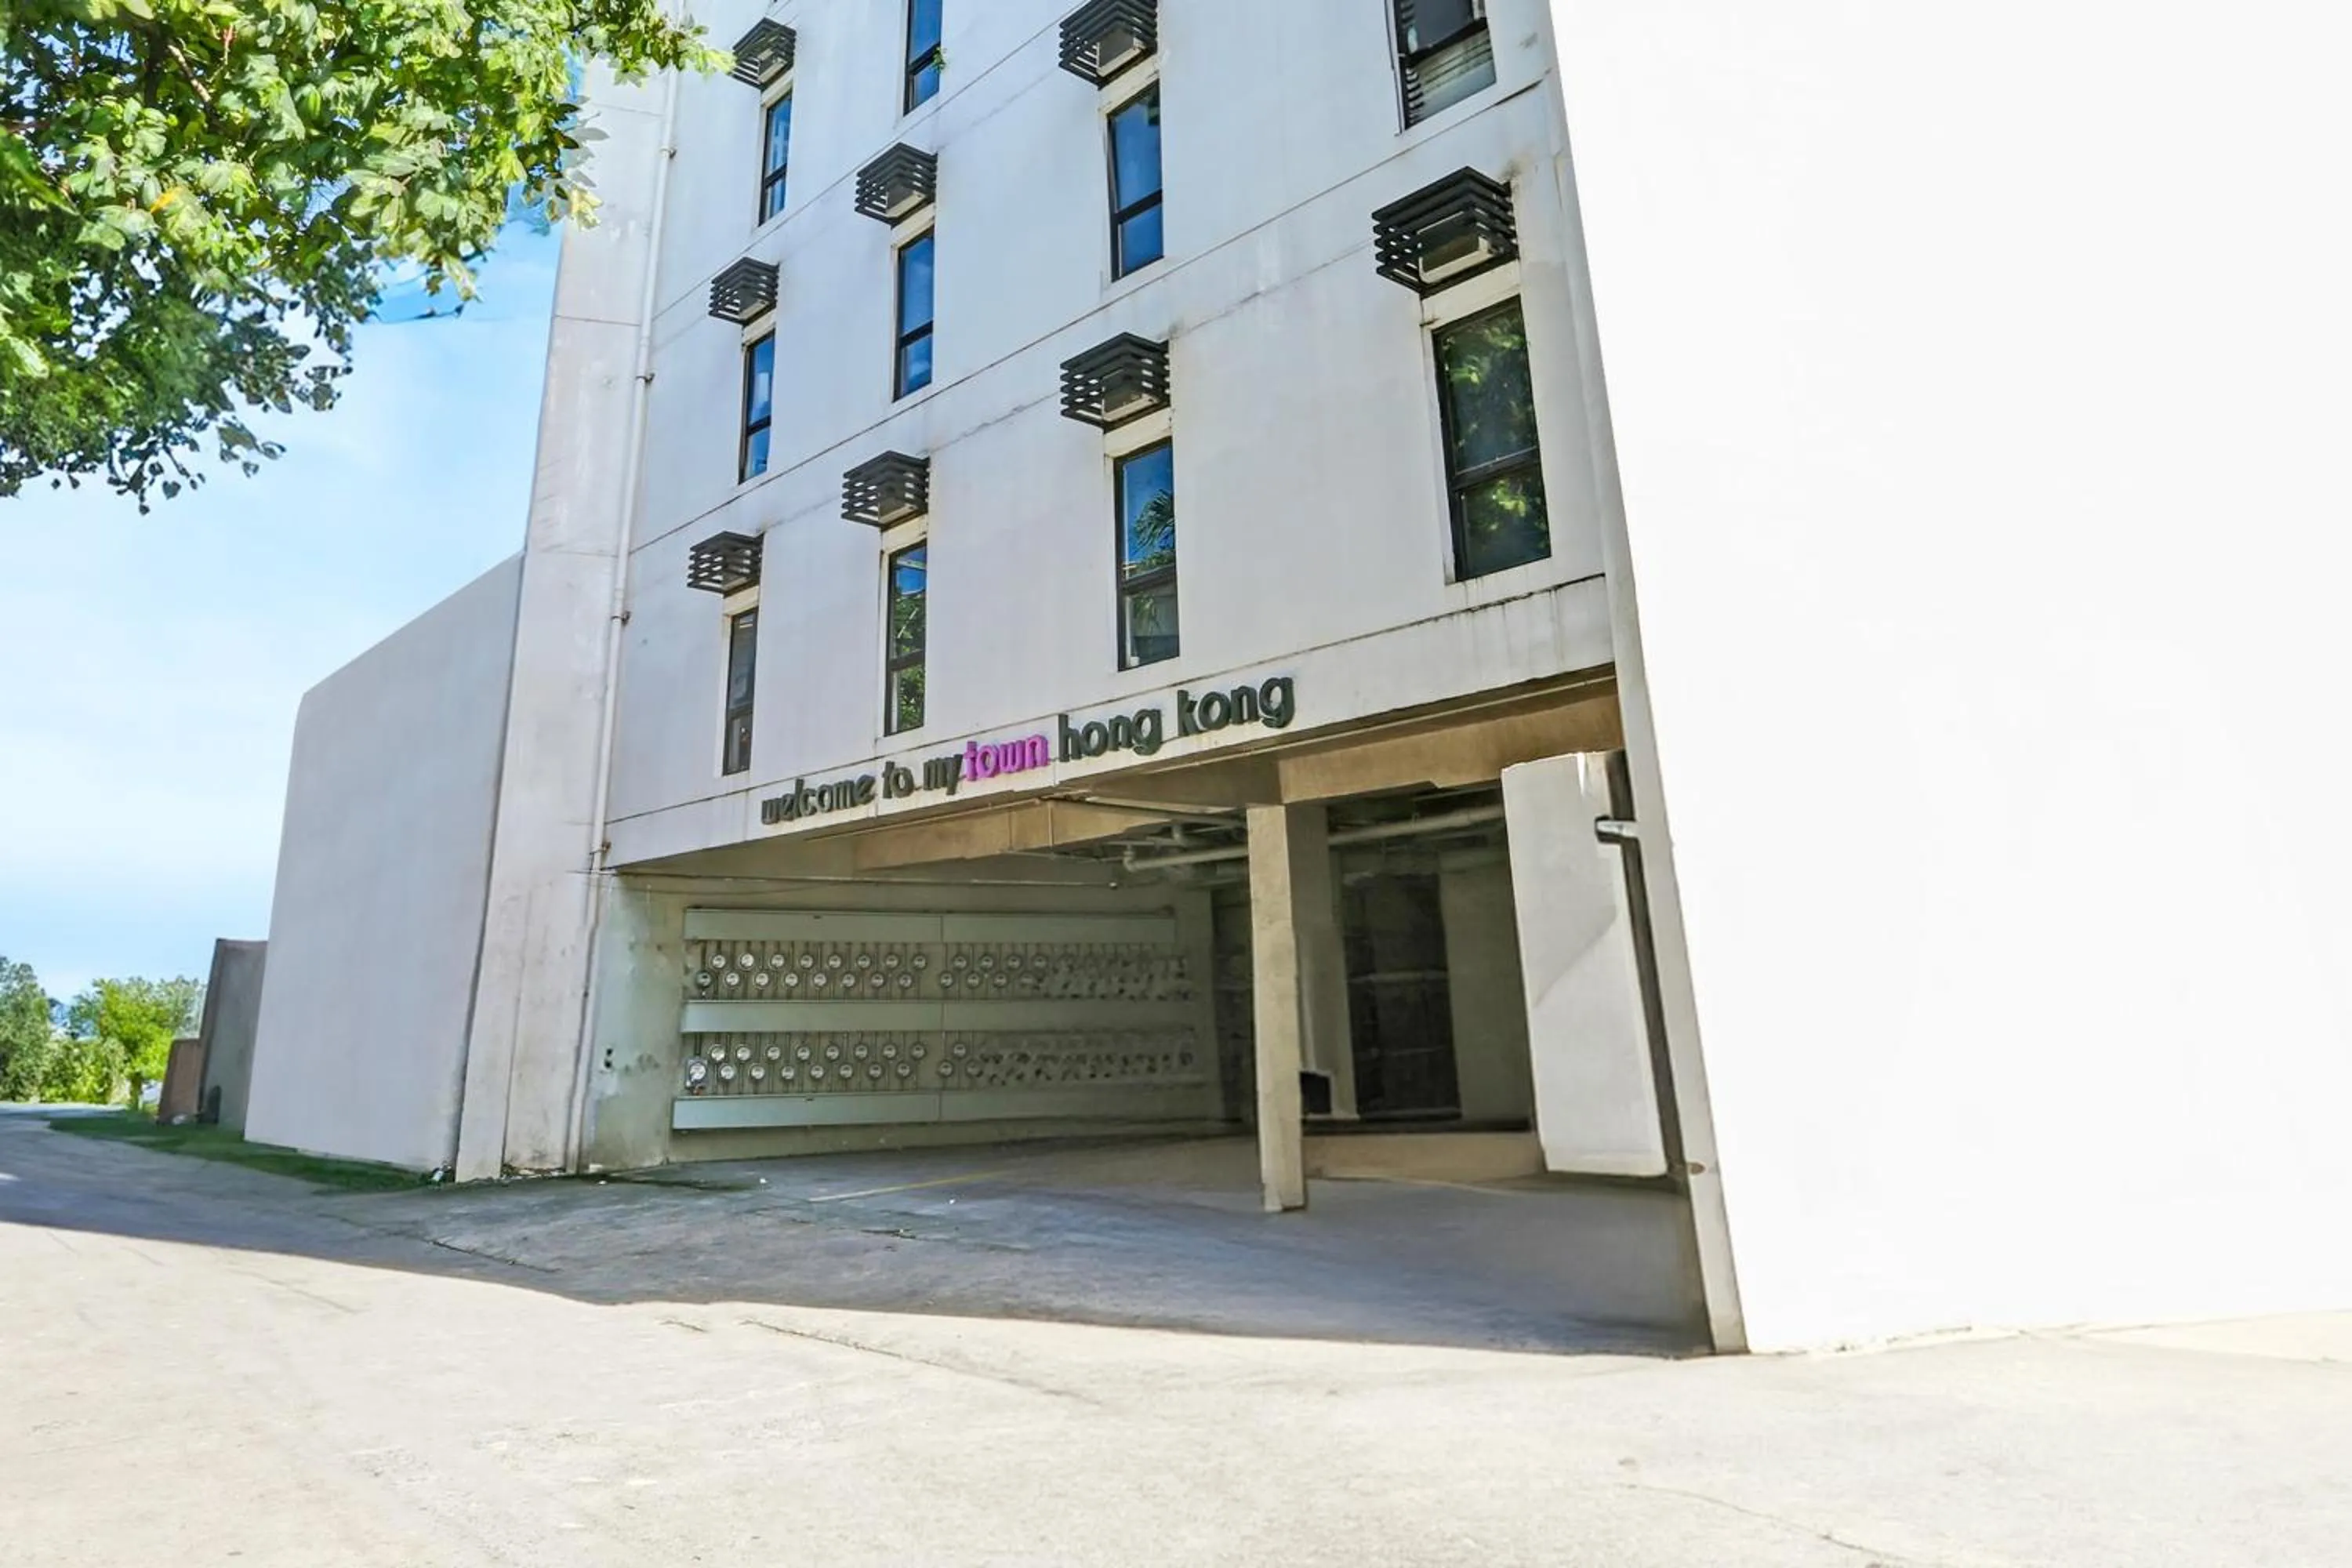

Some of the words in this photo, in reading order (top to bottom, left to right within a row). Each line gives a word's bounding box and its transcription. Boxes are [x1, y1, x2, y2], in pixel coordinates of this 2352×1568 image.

[760, 773, 876, 825] welcome
[882, 760, 915, 799] to
[1058, 708, 1163, 763] hong
[1177, 677, 1295, 737] kong
